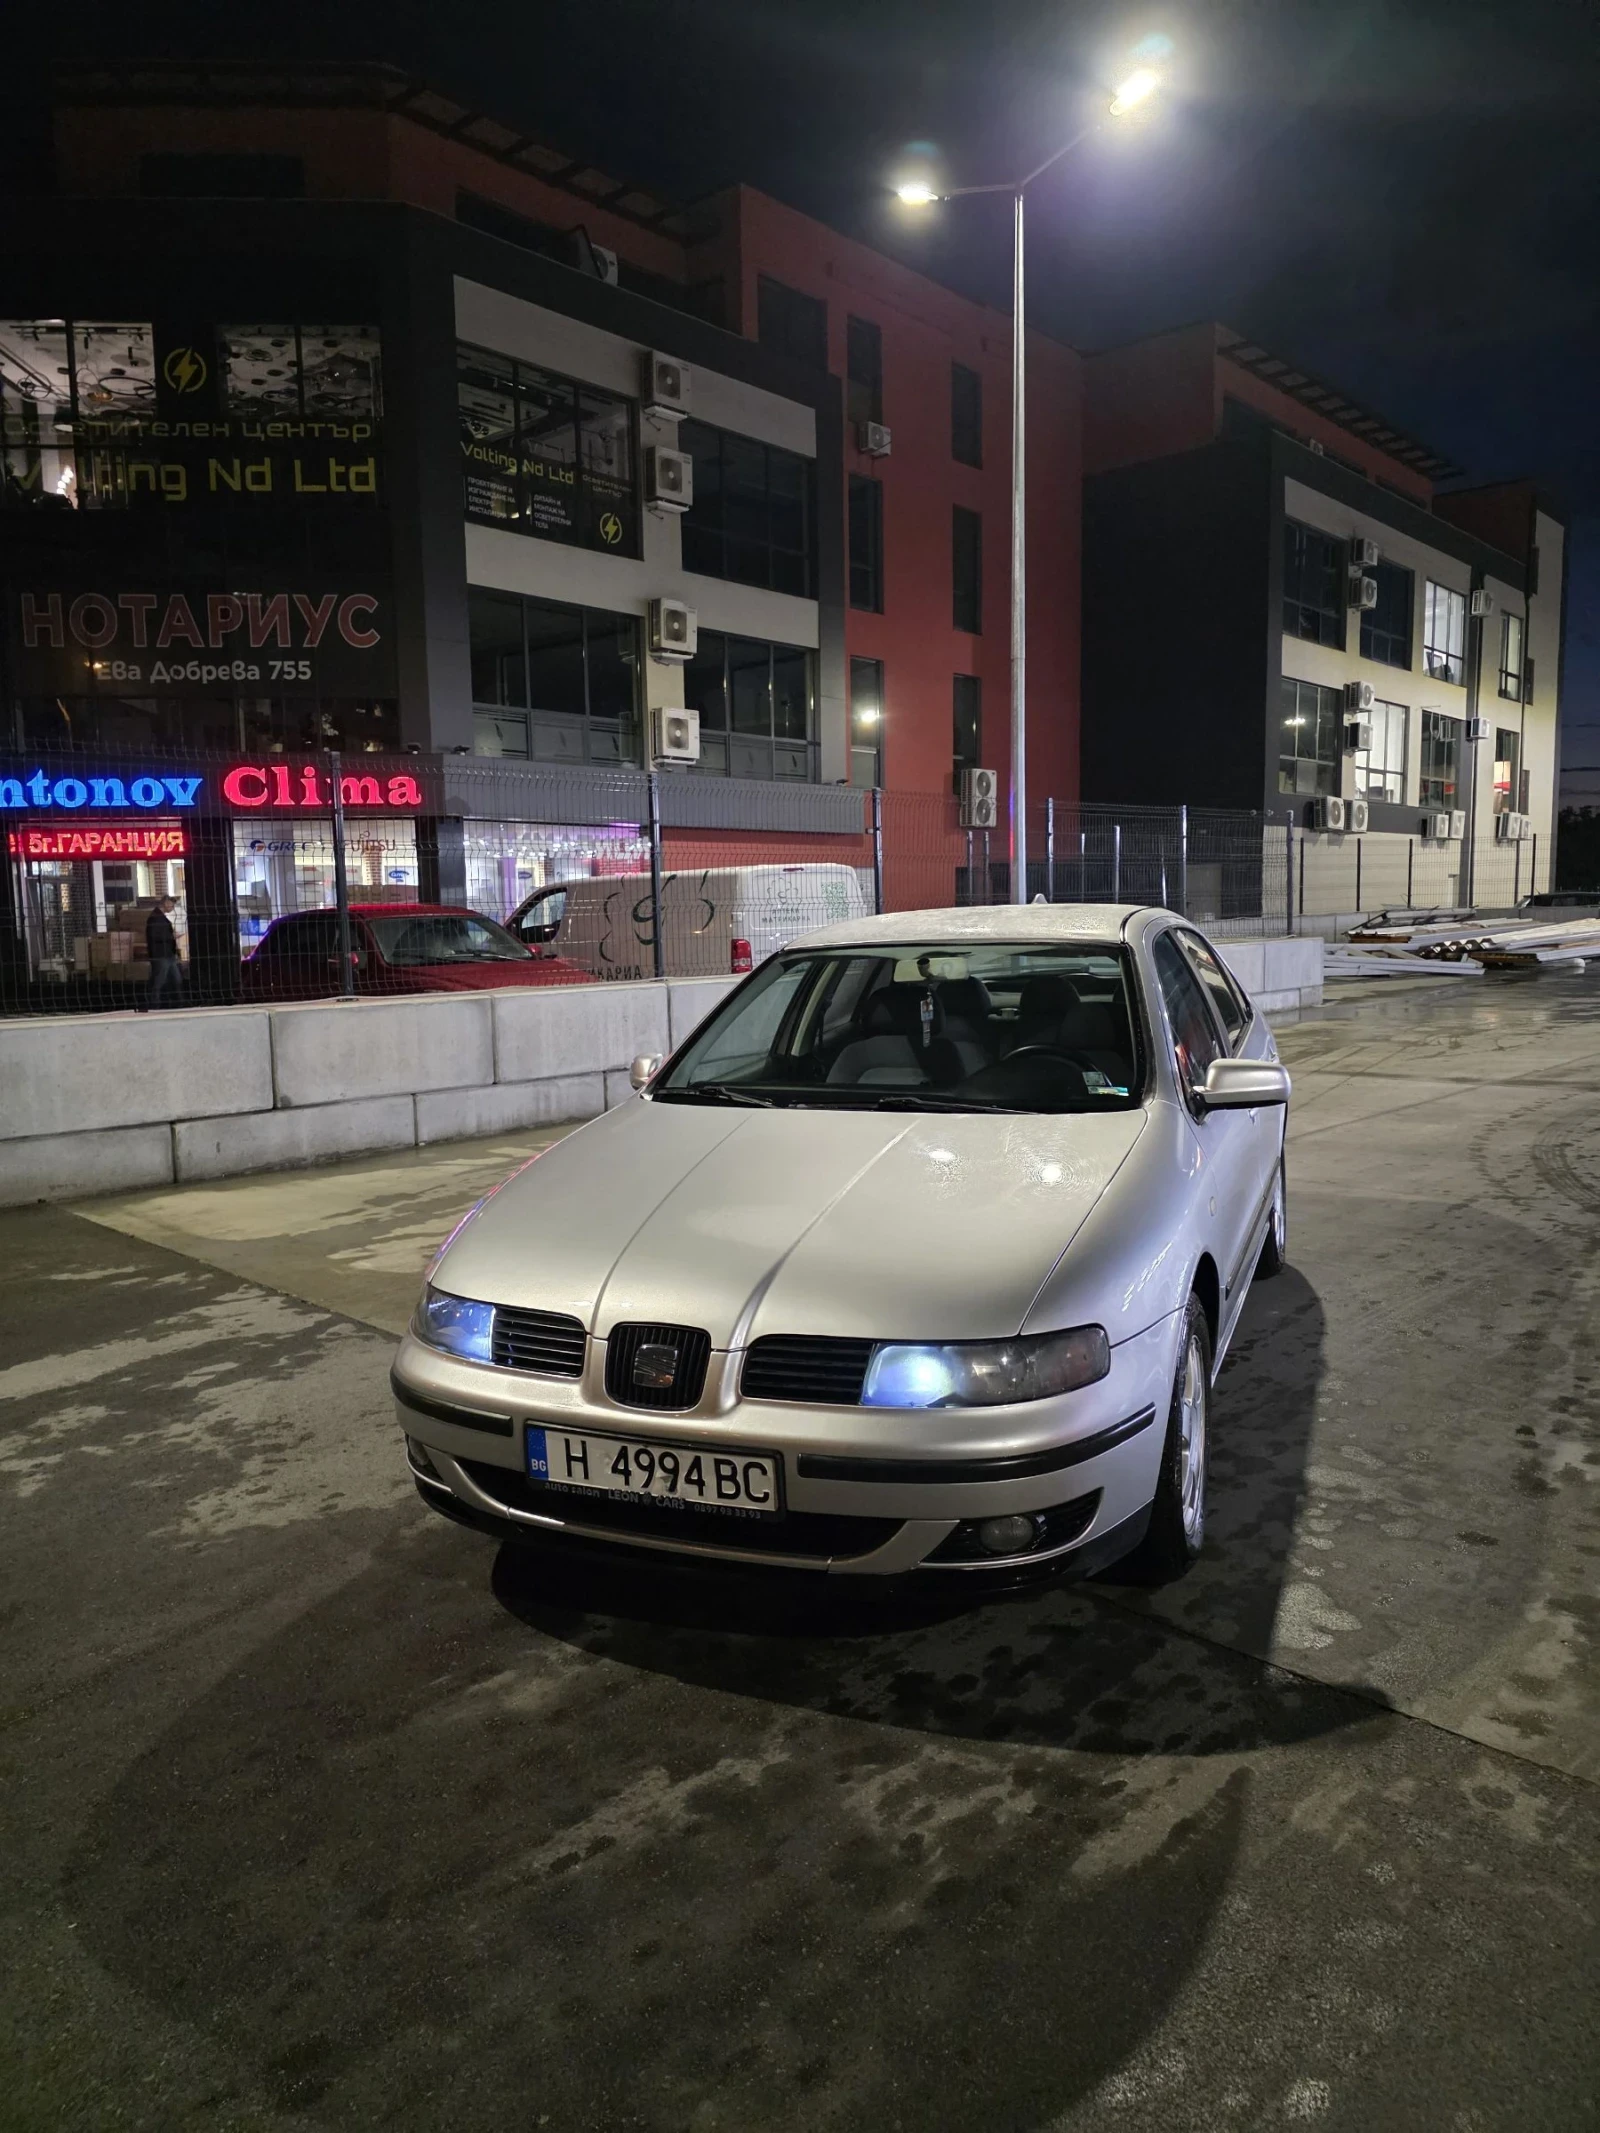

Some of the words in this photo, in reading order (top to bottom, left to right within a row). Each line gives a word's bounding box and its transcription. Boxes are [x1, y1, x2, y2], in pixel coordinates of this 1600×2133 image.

[242, 421, 372, 443] център
[8, 455, 188, 502] Vlting
[208, 457, 271, 492] Nd
[294, 456, 375, 492] Ltd
[460, 441, 517, 475] Volting
[522, 459, 544, 477] Nd
[549, 466, 574, 485] Ltd
[534, 503, 558, 514] МОНТАЖ
[20, 593, 381, 649] НОТАРИУС
[96, 660, 141, 681] Ева
[150, 660, 260, 684] Добрева
[268, 661, 312, 681] 755
[224, 765, 422, 807] Clima
[531, 1458, 547, 1472] BG
[564, 1438, 590, 1481] H
[544, 1482, 569, 1493] auto
[571, 1486, 601, 1498] salon
[608, 1489, 639, 1504] LEON
[655, 1497, 686, 1510] CARS
[693, 1503, 718, 1514] 0897
[748, 1510, 761, 1519] 93
